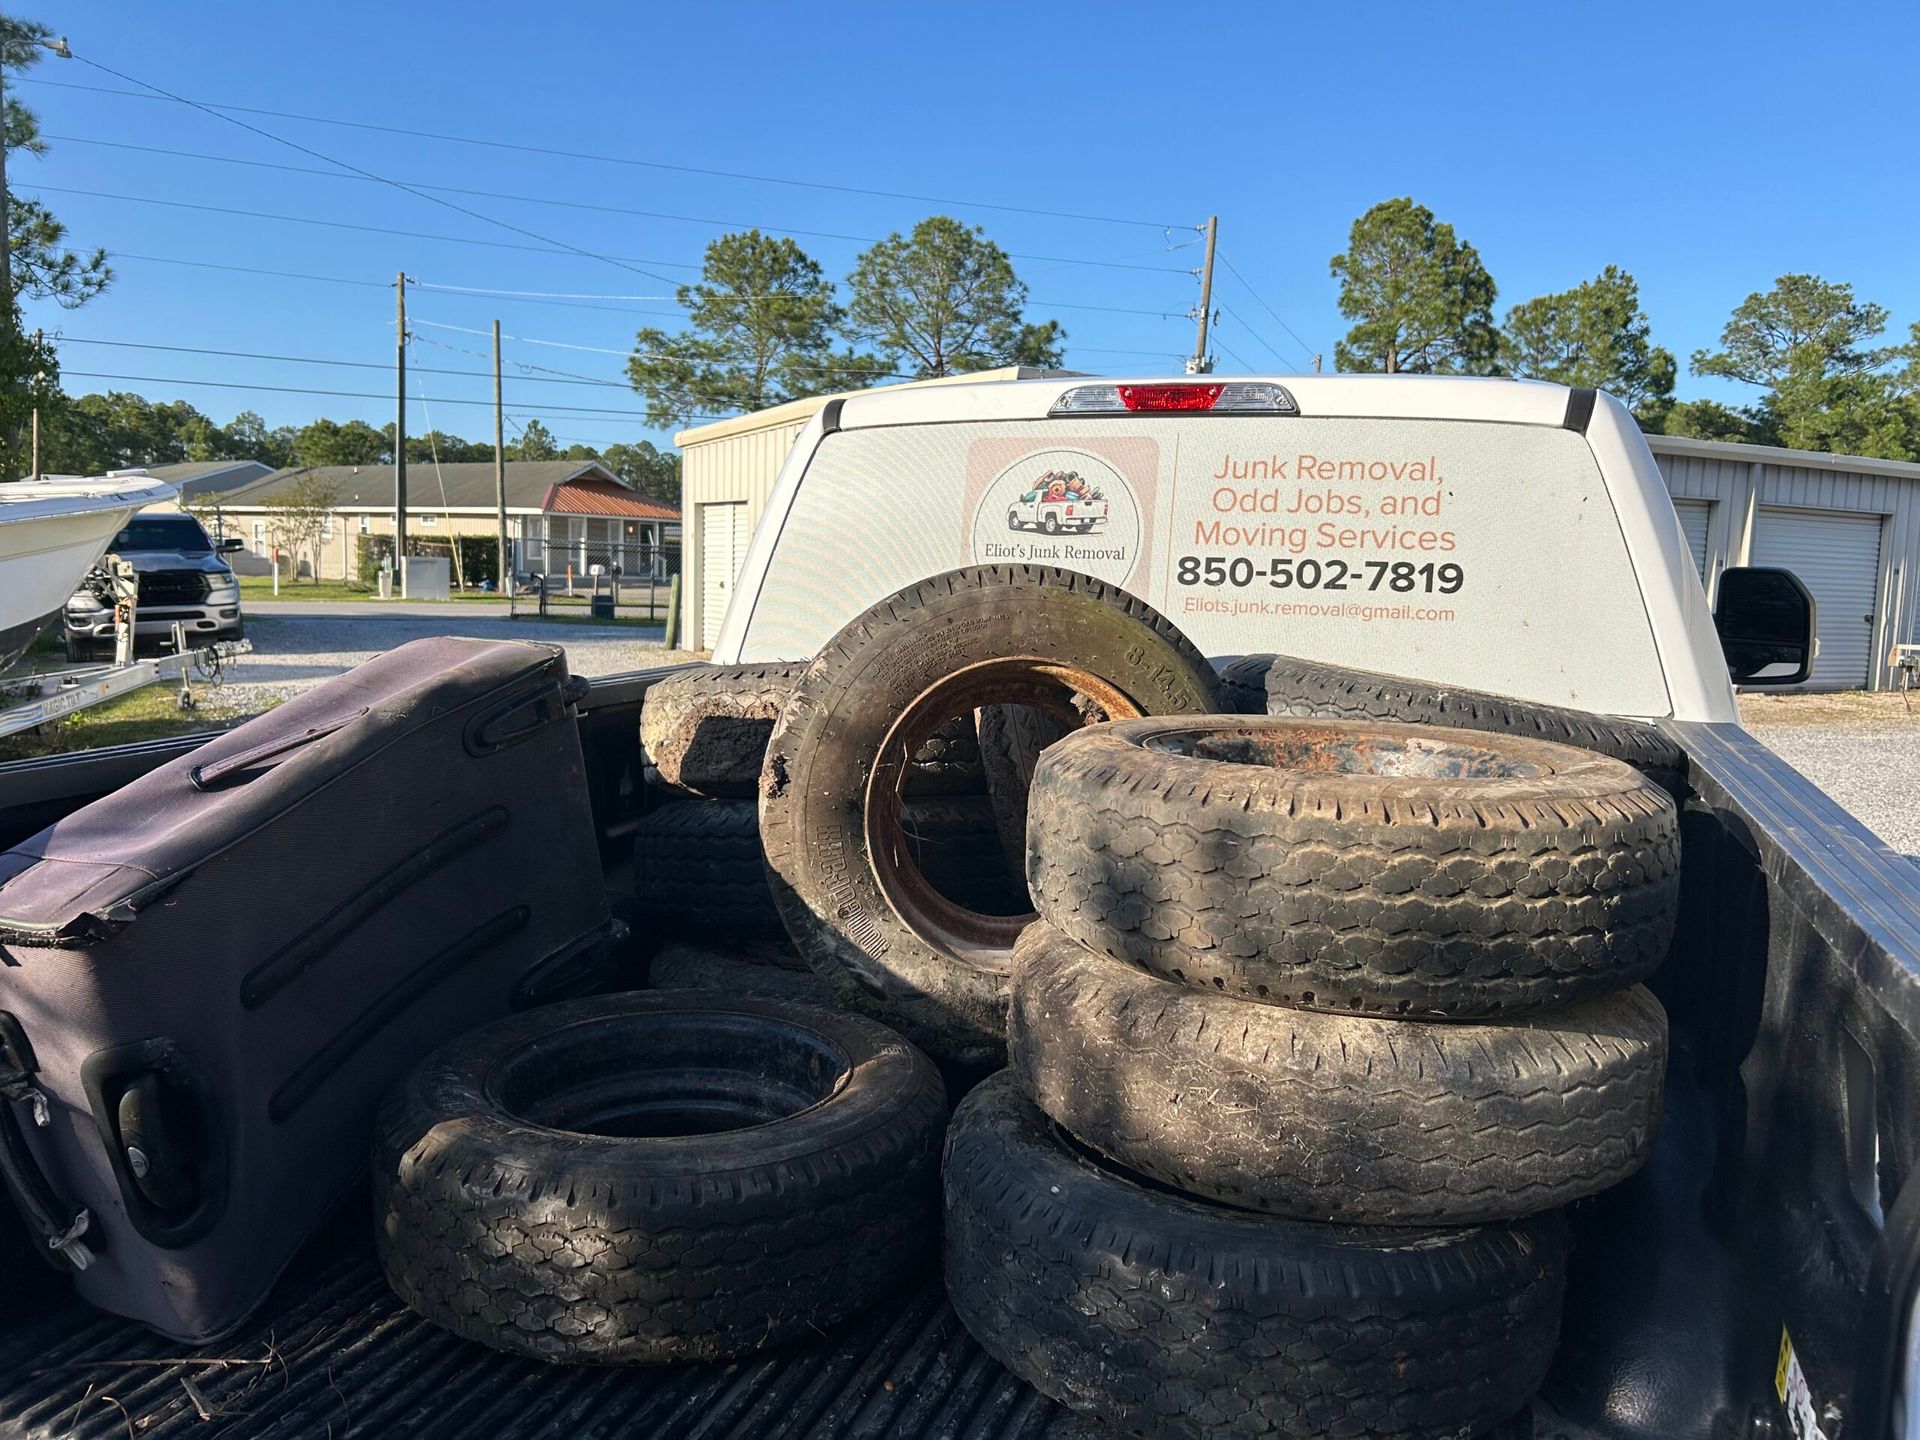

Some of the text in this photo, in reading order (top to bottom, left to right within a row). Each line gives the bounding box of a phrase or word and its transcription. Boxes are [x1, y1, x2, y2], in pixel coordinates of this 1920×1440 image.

[1214, 455, 1444, 485] Junk Removal,
[1212, 488, 1441, 518] Odd Jobs, and
[984, 544, 1125, 561] Eliot's Junk Removal
[1194, 521, 1456, 554] Moving Services
[1177, 556, 1465, 594] 850-502-7819
[1184, 597, 1455, 621] Eliots.junk.removal@gmail.com
